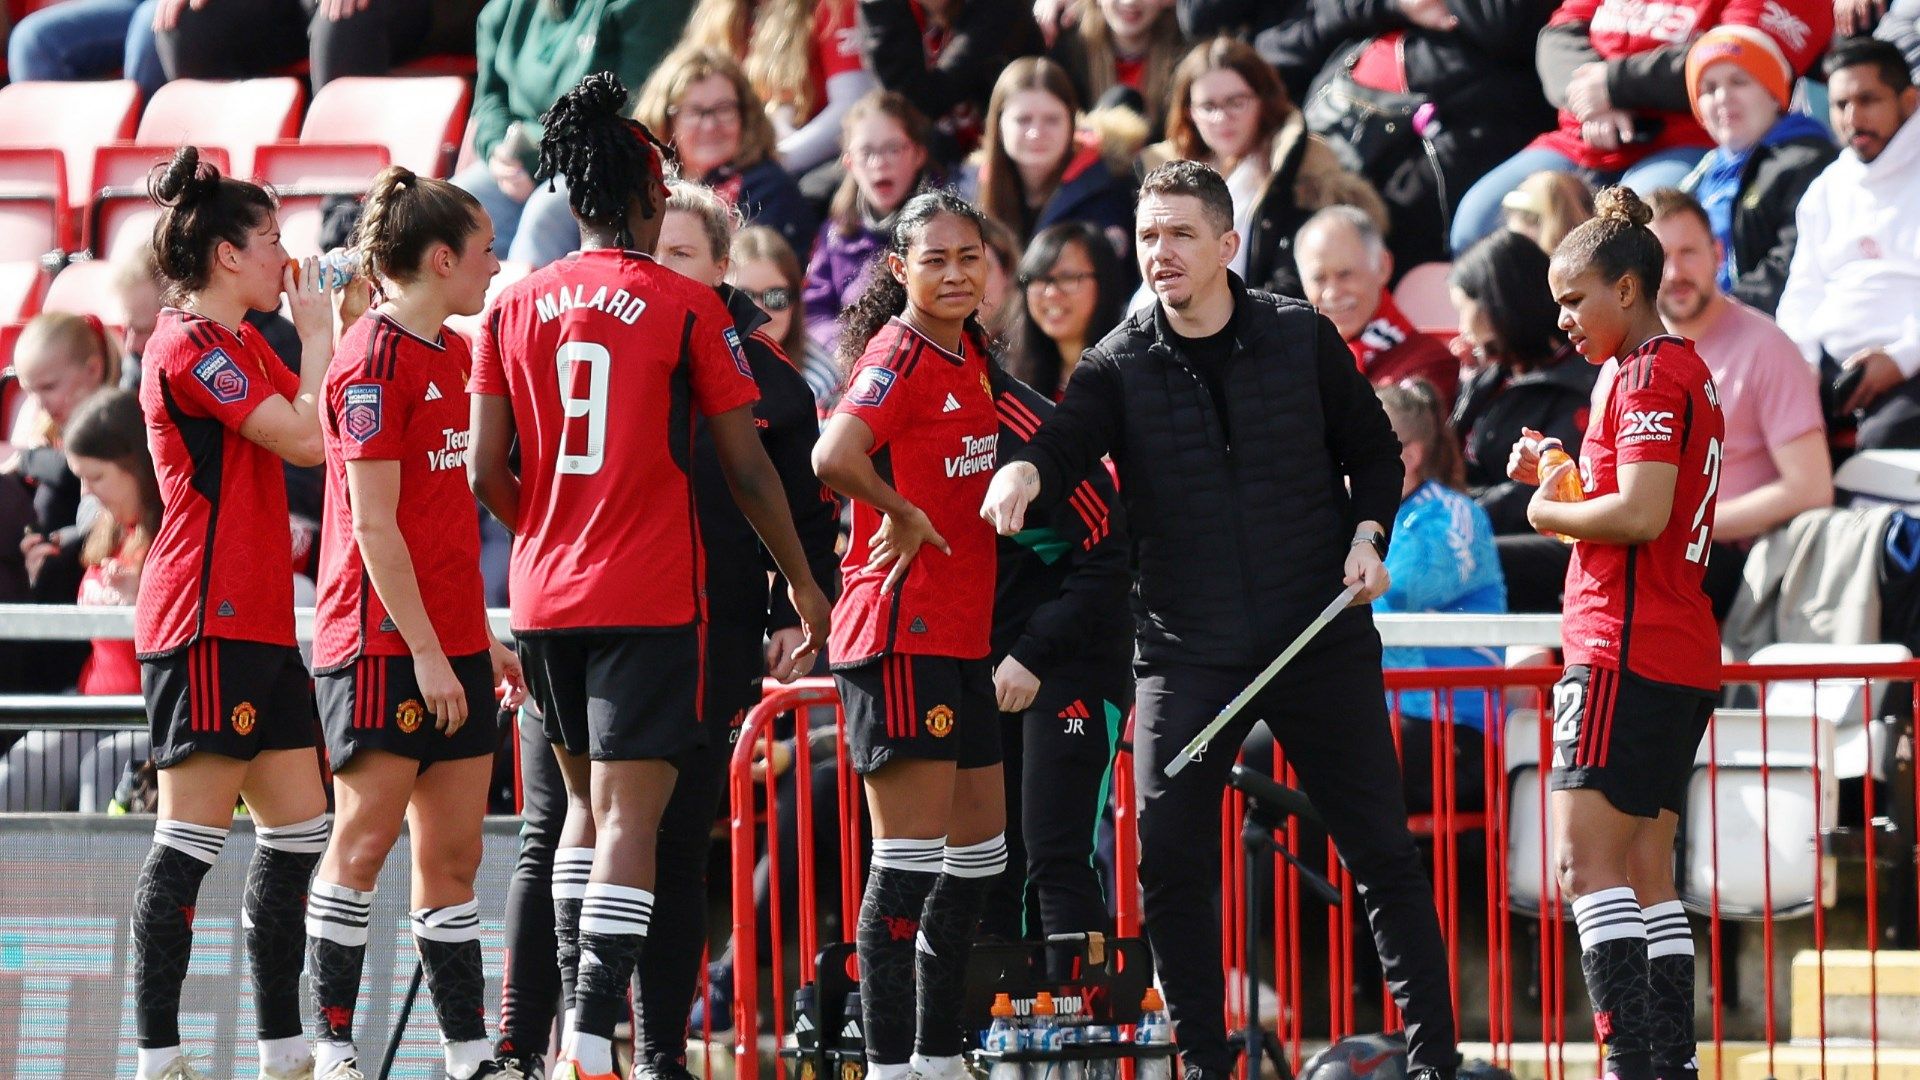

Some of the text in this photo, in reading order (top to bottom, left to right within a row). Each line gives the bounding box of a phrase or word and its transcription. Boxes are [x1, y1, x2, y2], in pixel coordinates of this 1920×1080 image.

[534, 283, 647, 326] MALARD
[556, 340, 611, 476] 9
[962, 434, 995, 457] Team
[1624, 433, 1671, 442] TECHNOLOGY
[944, 452, 994, 478] Viewer
[1684, 436, 1725, 568] 2
[1063, 718, 1085, 735] JR
